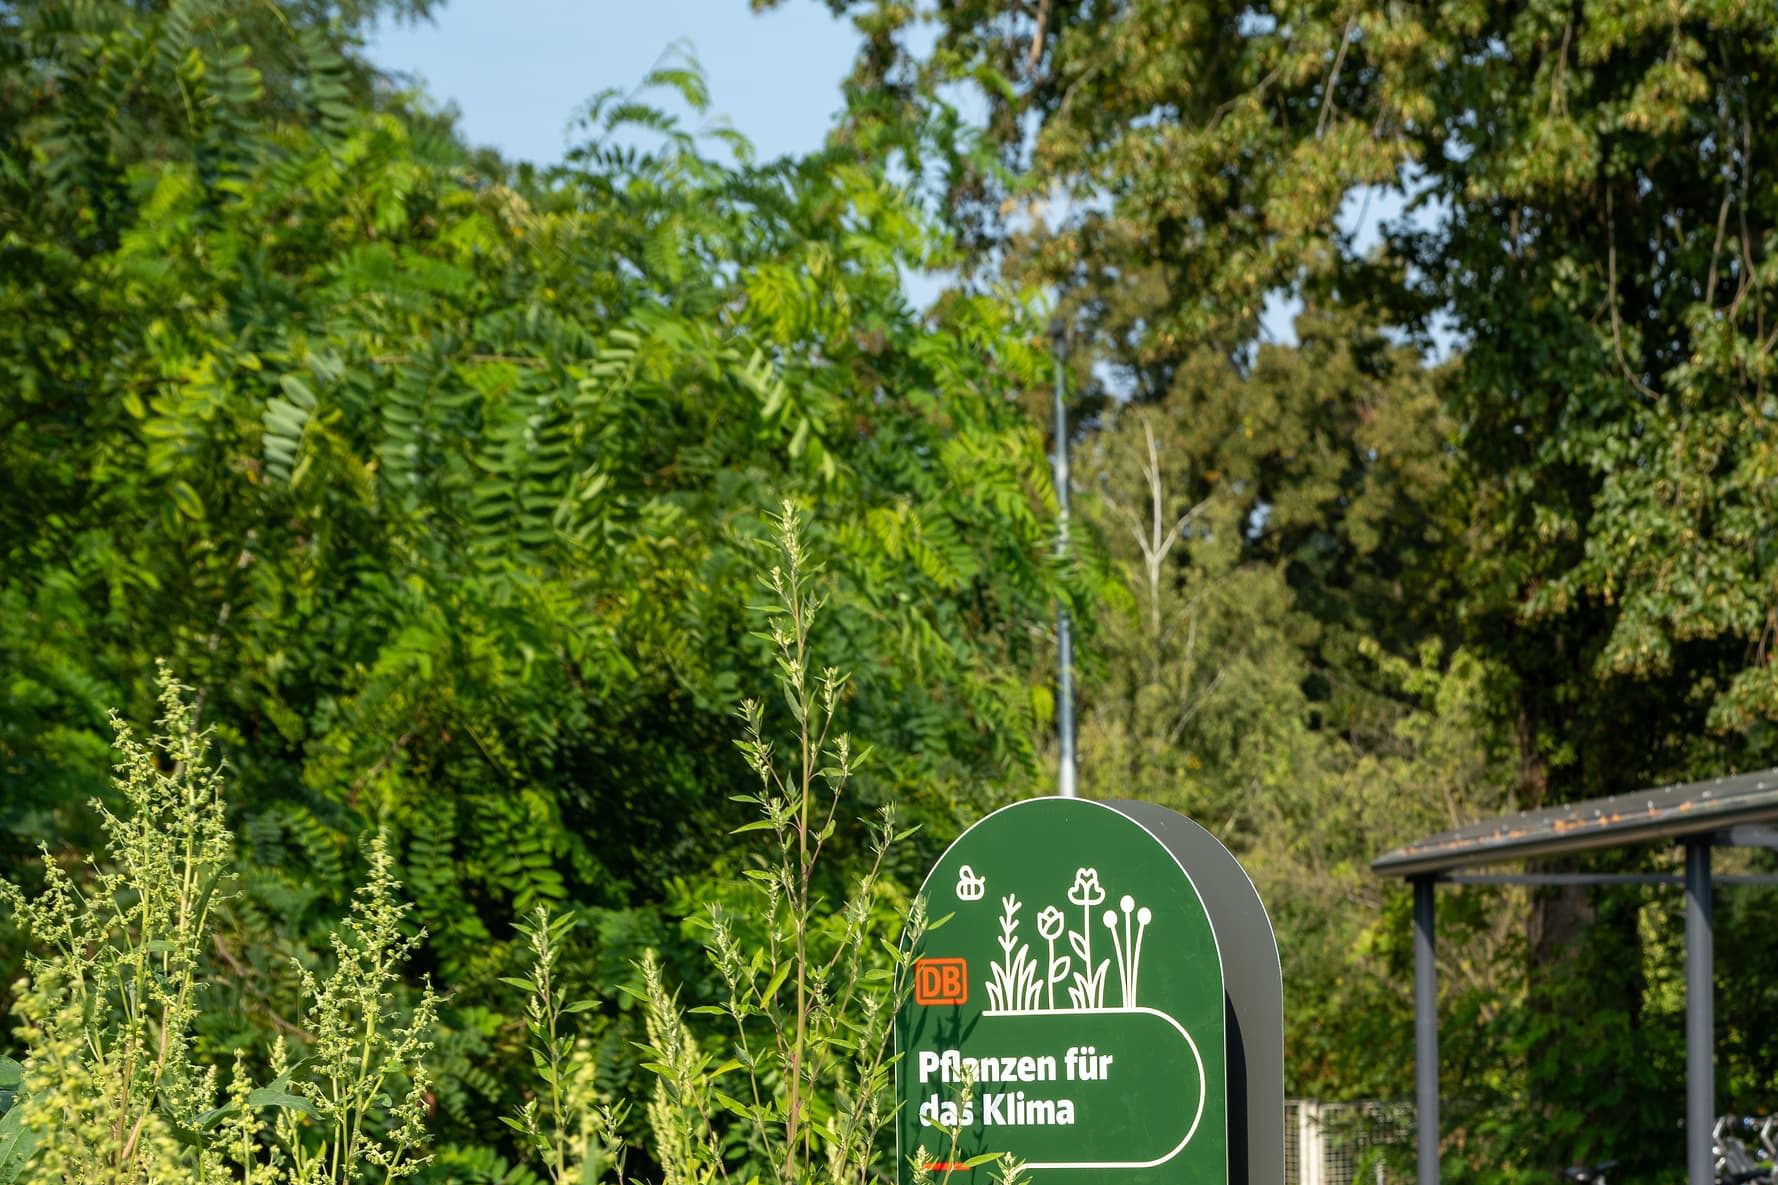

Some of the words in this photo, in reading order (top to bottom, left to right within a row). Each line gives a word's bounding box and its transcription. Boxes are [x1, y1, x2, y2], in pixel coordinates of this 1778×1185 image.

[922, 965, 961, 998] DB
[918, 1049, 1056, 1084] Pflanzen
[1064, 1046, 1113, 1081] für
[919, 1093, 974, 1127] das
[982, 1090, 1075, 1126] Klima
